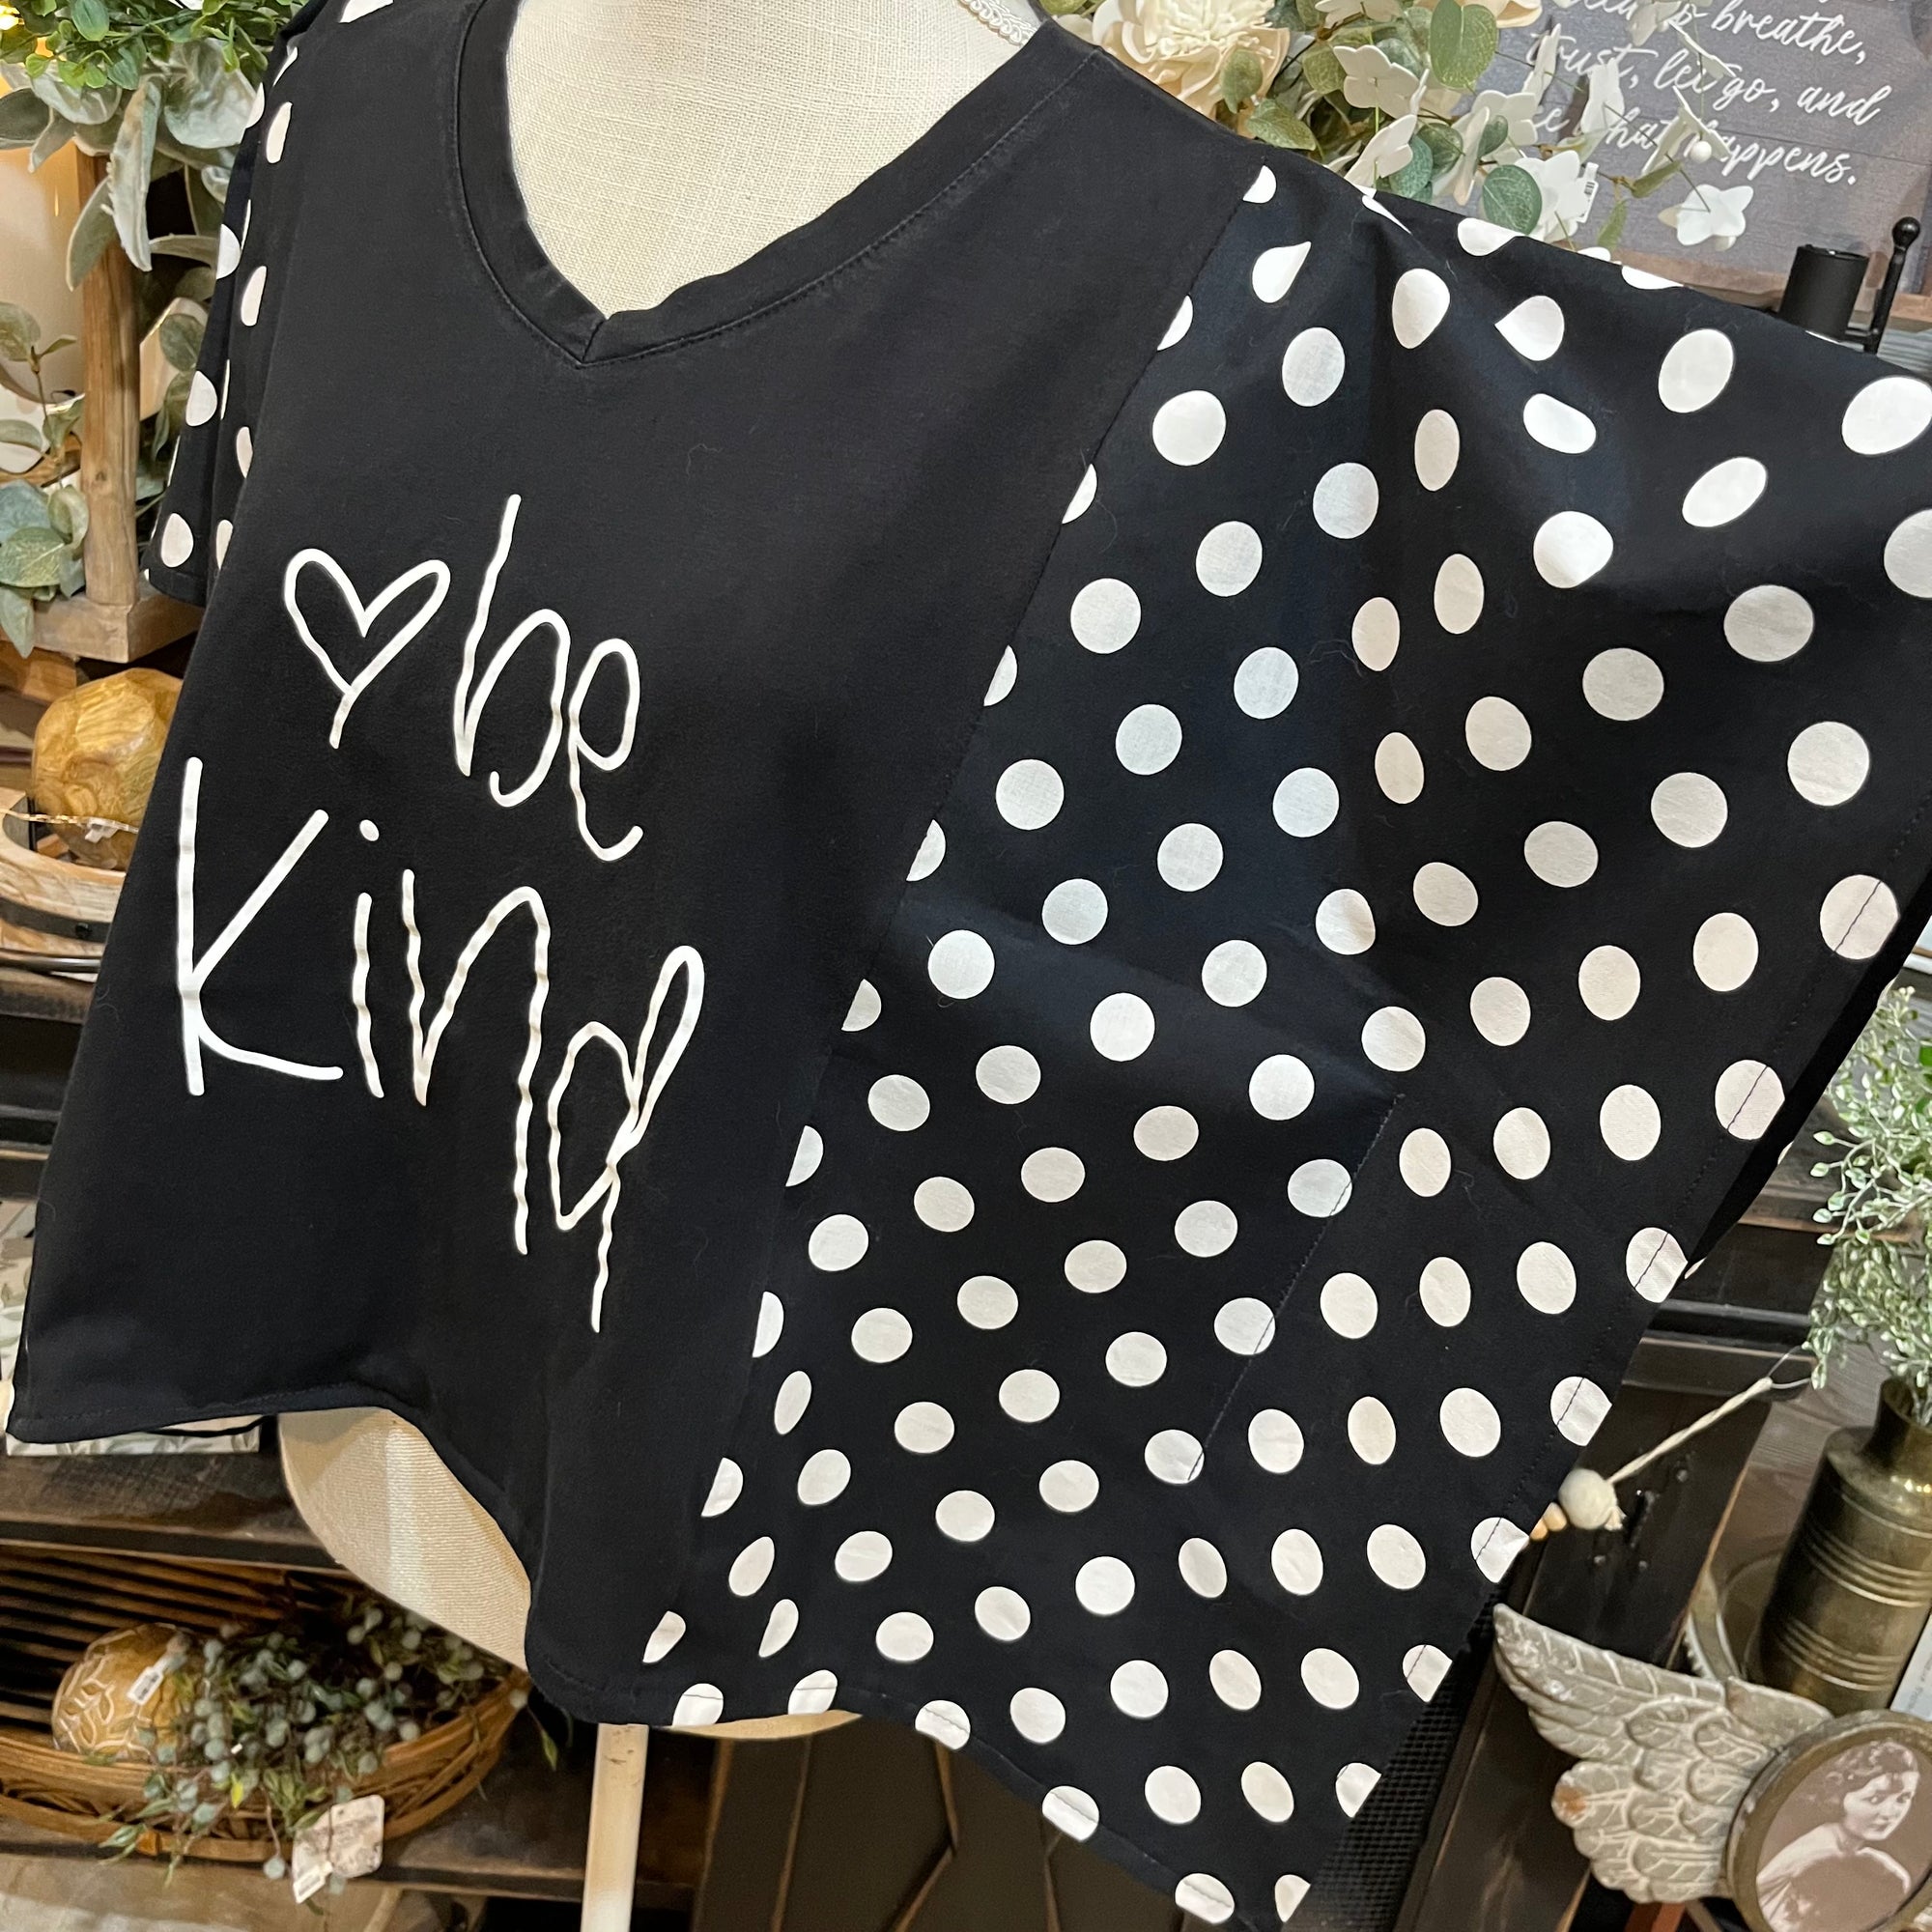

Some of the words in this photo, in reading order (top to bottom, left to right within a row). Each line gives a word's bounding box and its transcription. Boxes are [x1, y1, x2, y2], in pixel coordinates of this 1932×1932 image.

[1711, 0, 1866, 65] breathe,
[1605, 106, 1679, 150] hat
[1713, 77, 1779, 112] go,
[1797, 85, 1892, 126] and
[453, 494, 644, 862] be
